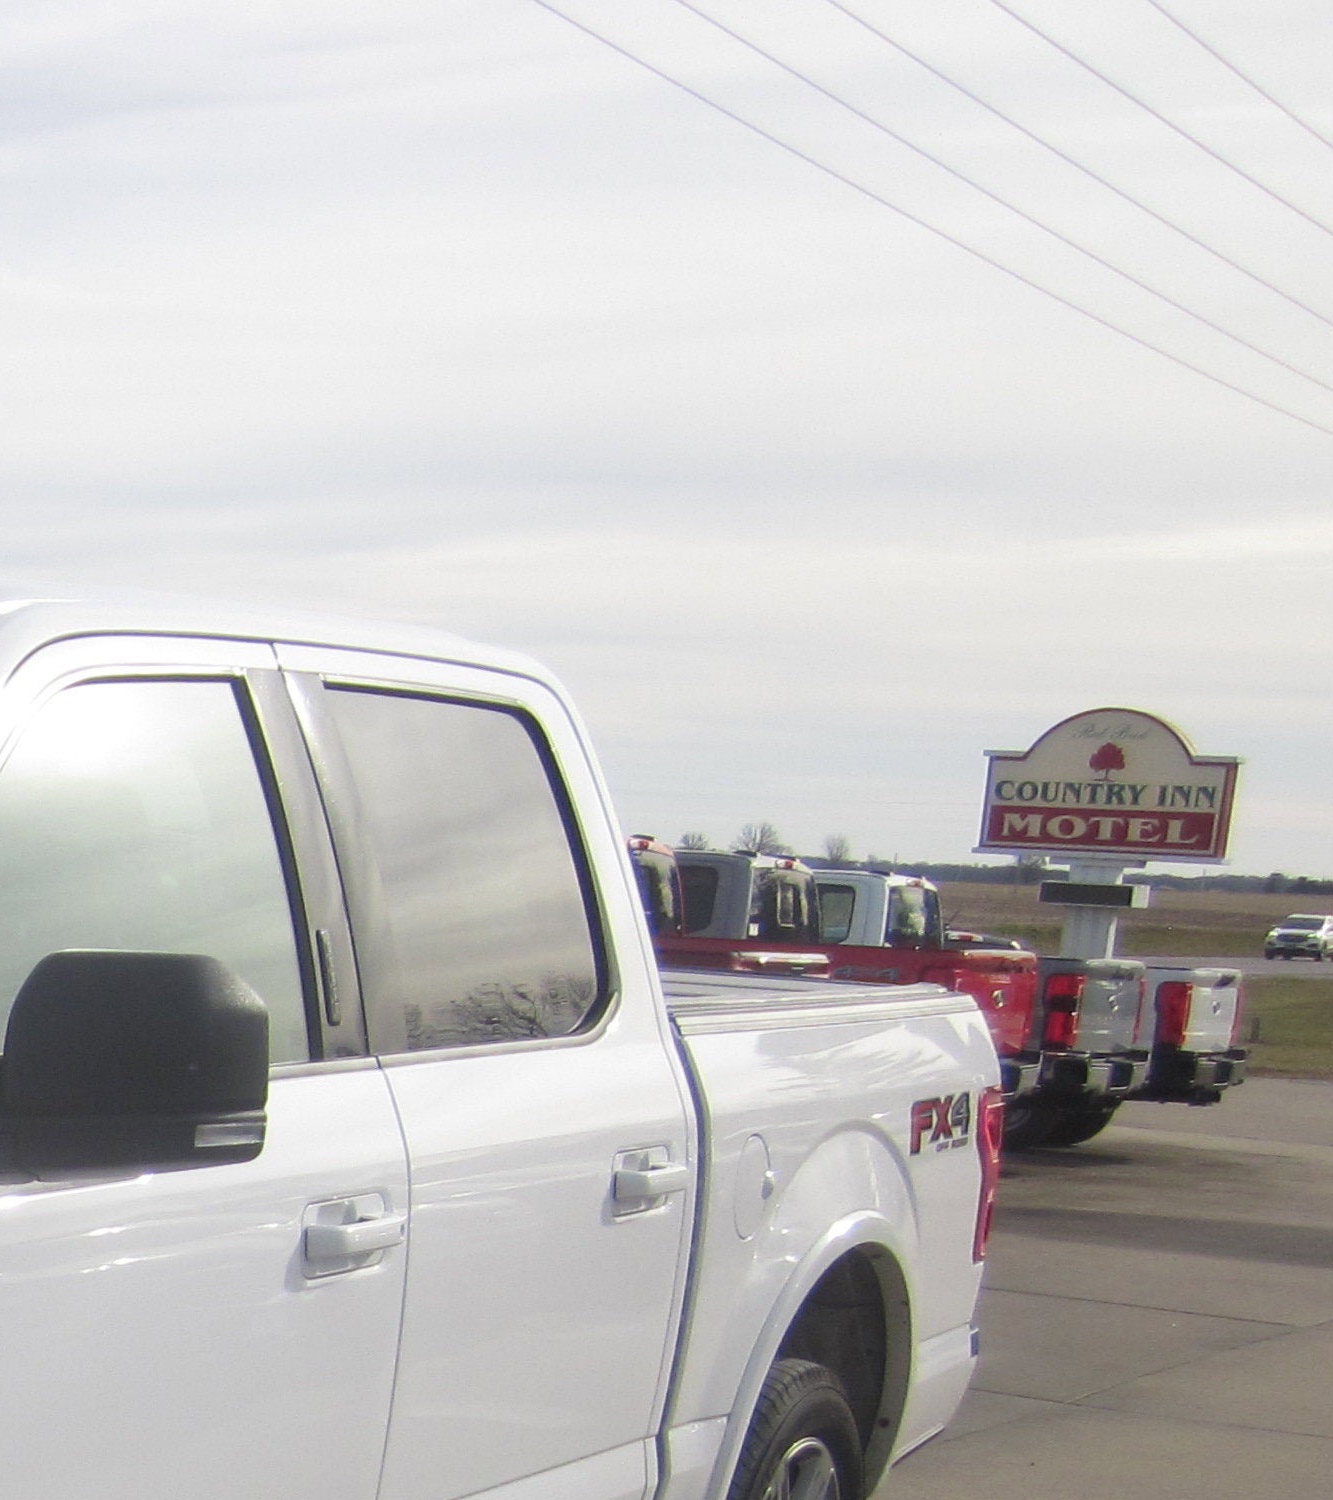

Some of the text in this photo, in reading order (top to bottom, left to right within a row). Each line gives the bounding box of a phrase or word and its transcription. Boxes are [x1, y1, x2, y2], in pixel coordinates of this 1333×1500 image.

[993, 779, 1216, 809] COUNTRY INN
[1001, 812, 1199, 844] MOTEL
[908, 1090, 971, 1157] FX4
